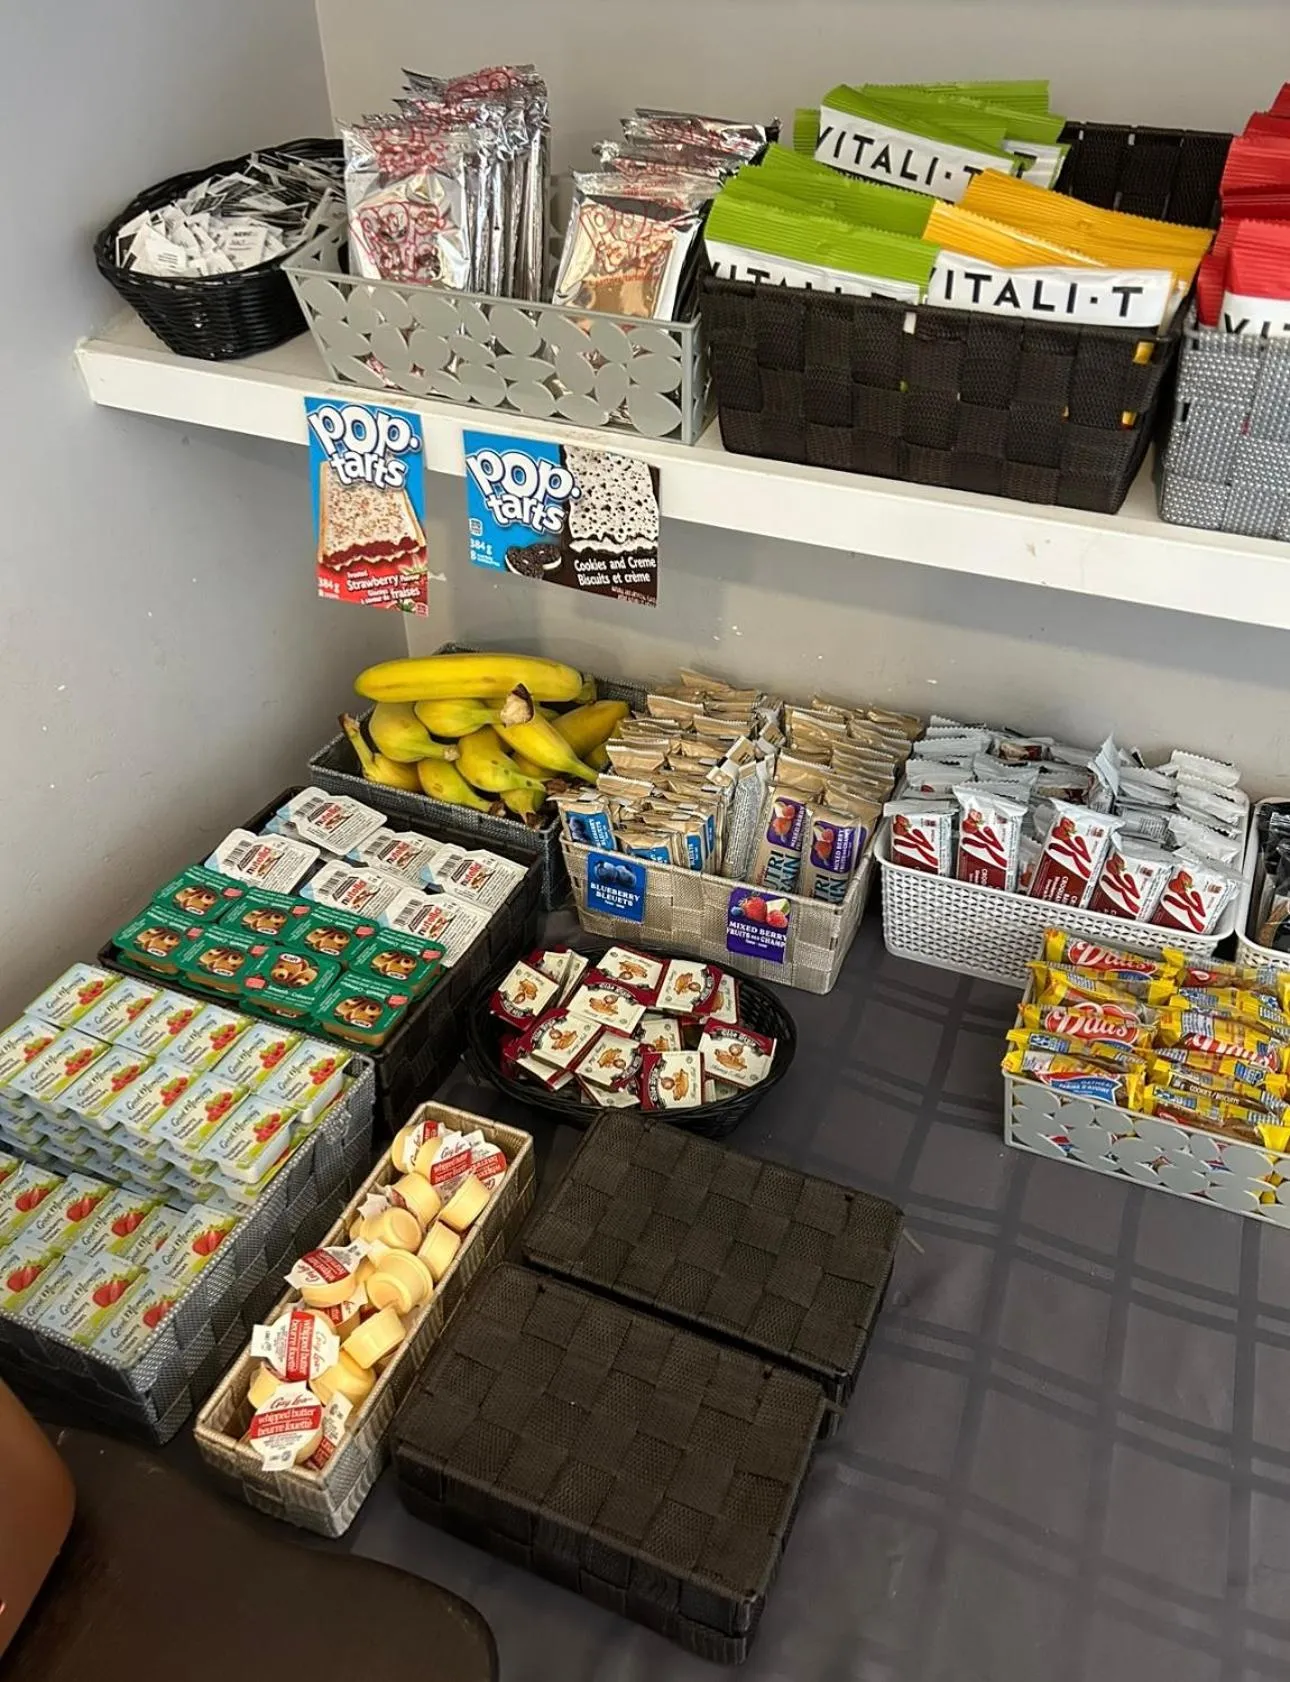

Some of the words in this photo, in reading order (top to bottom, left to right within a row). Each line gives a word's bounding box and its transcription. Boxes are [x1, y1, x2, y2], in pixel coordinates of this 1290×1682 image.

[928, 266, 1144, 318] ITALI·T
[574, 558, 607, 571] Cookies
[609, 556, 627, 570] and
[627, 556, 657, 568] Creme
[346, 575, 398, 591] Strawberry
[577, 572, 610, 586] Biscuits
[612, 572, 623, 584] et
[624, 570, 651, 583] crème
[390, 587, 420, 599] fraises
[590, 882, 641, 902] BLUEBERRY
[596, 890, 634, 907] BLEUETS
[729, 921, 758, 934] MIXED
[760, 928, 787, 941] BERRY
